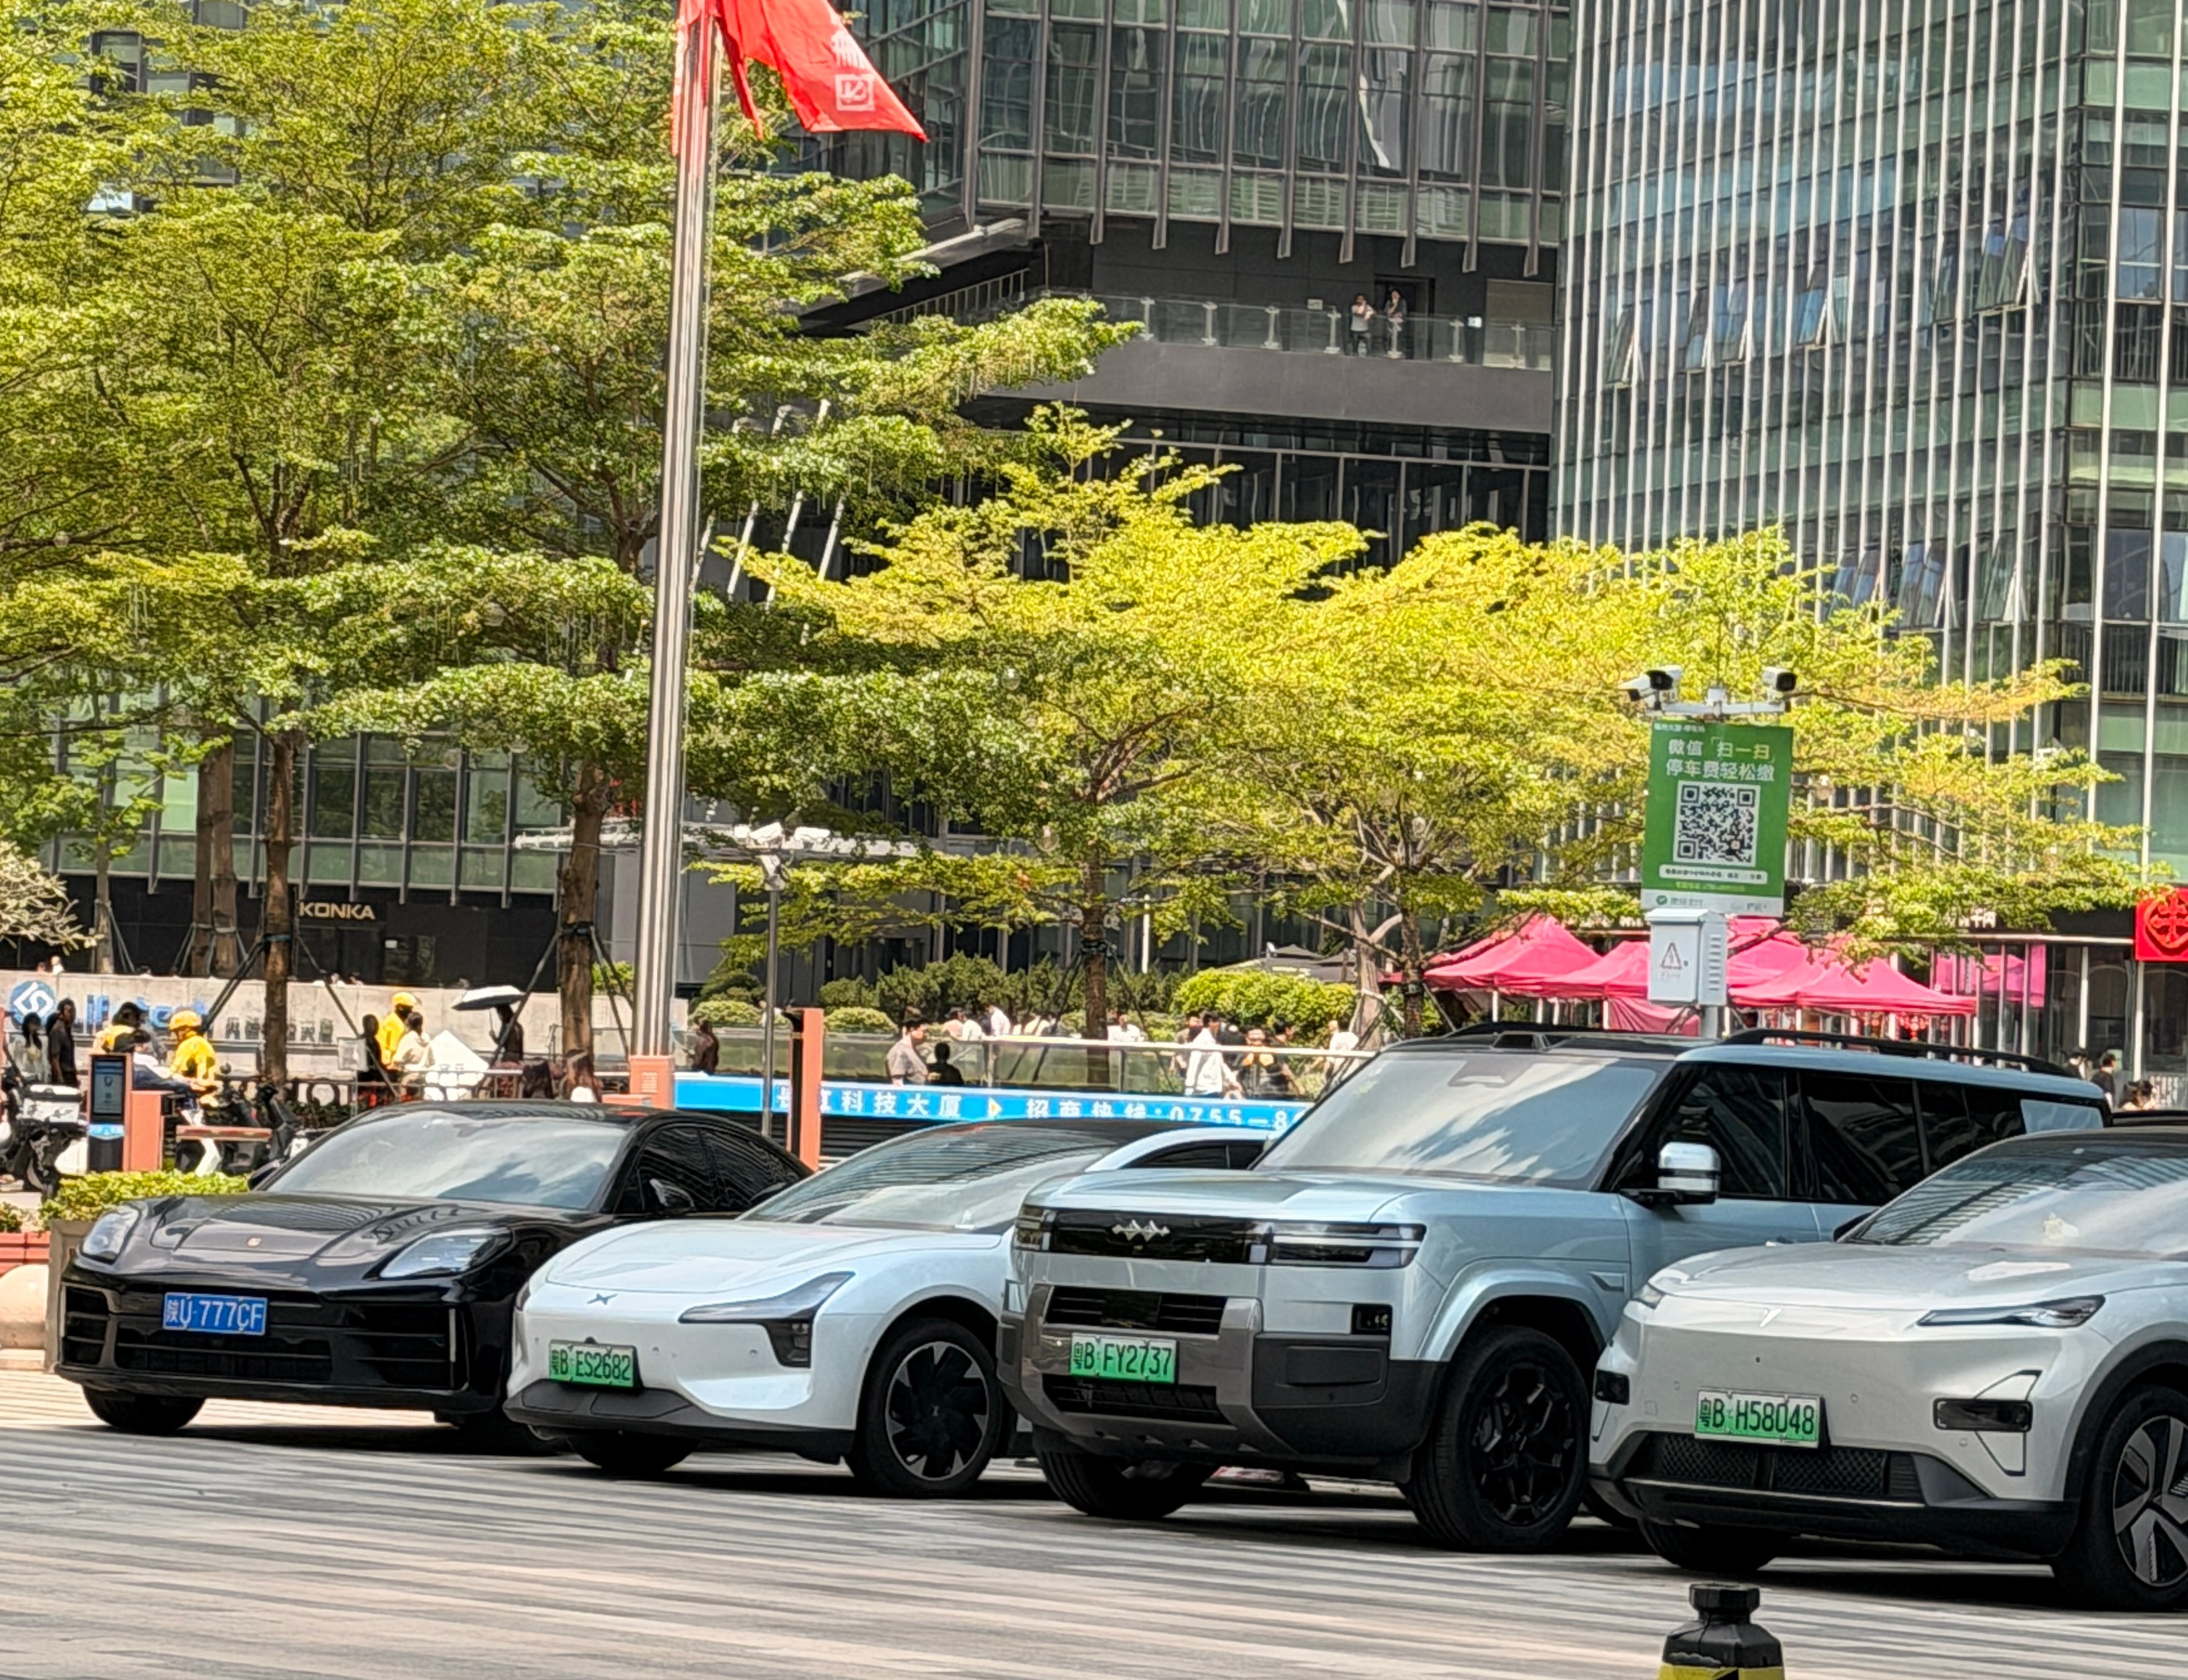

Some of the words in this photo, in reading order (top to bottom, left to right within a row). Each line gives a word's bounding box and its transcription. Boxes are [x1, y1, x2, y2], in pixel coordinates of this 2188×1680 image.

[1667, 758, 1774, 781] 停车费轻松缴
[299, 901, 375, 920] KONKA
